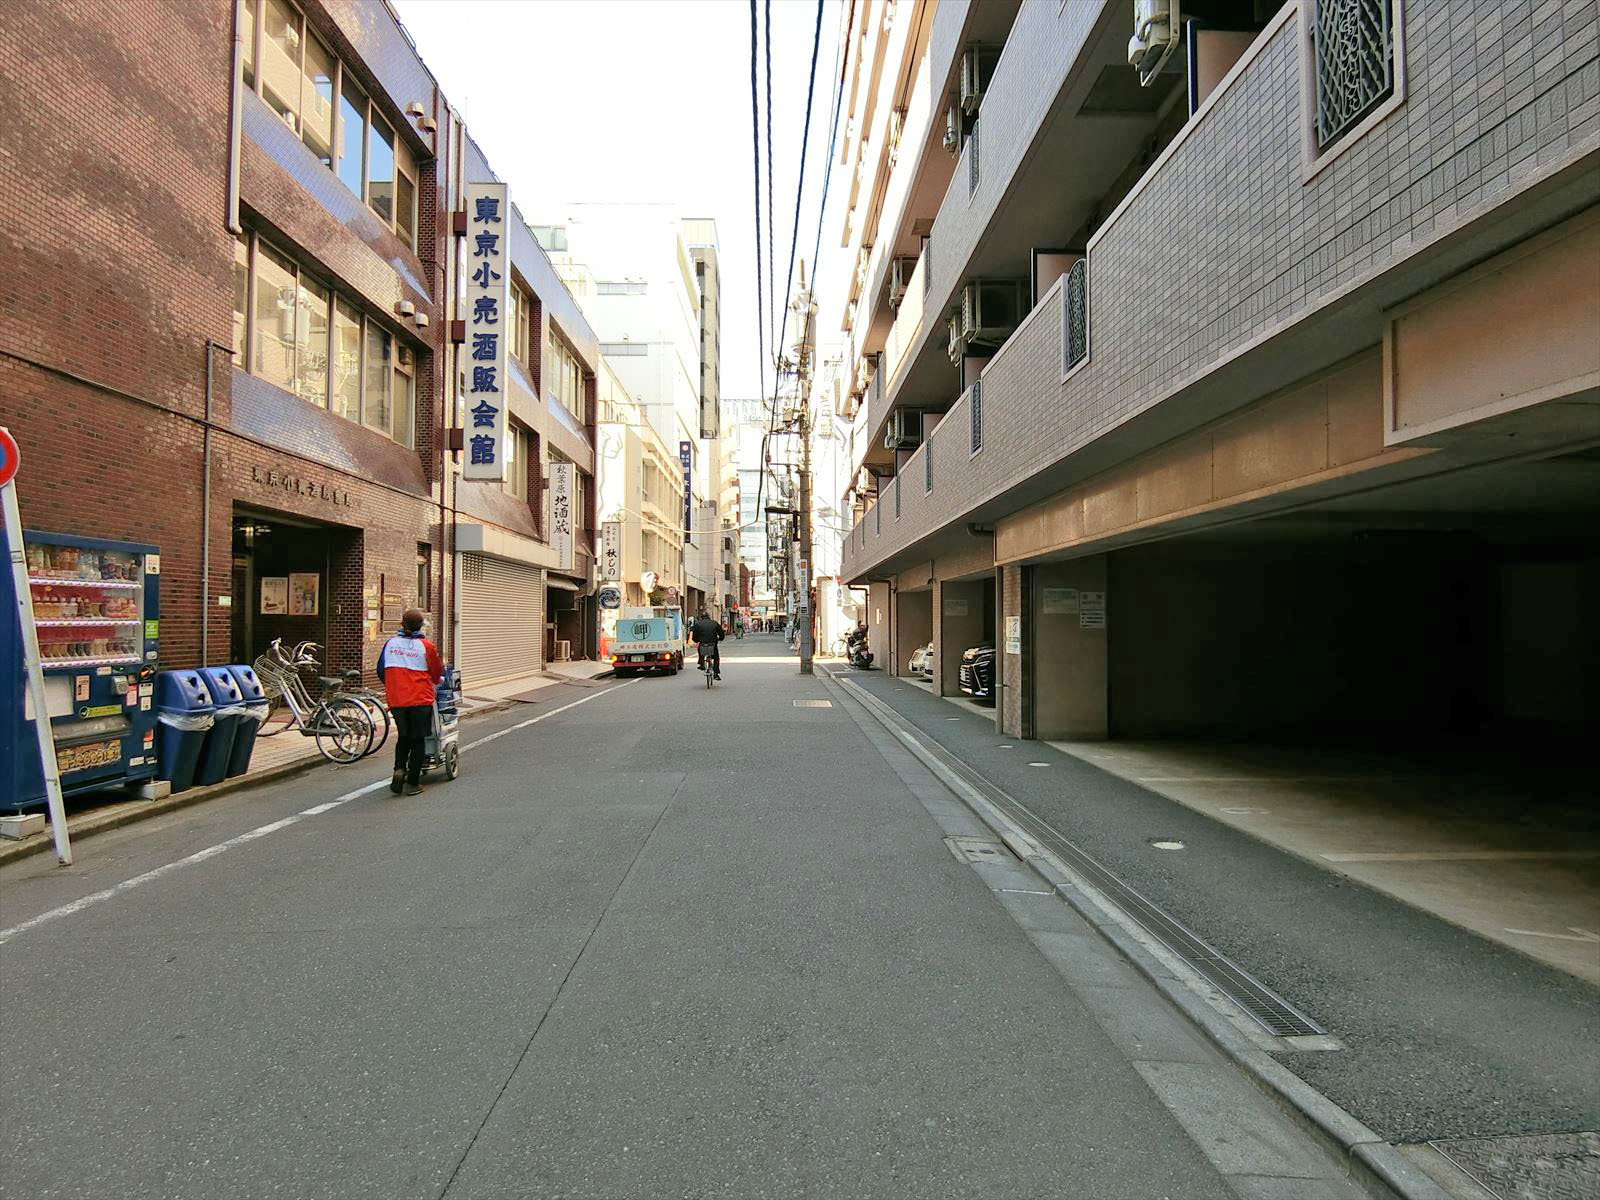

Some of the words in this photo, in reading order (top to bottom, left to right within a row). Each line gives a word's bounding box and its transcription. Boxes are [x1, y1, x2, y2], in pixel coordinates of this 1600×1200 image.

[470, 195, 501, 465] 東京小売酒販会館
[634, 624, 648, 639] 岬
